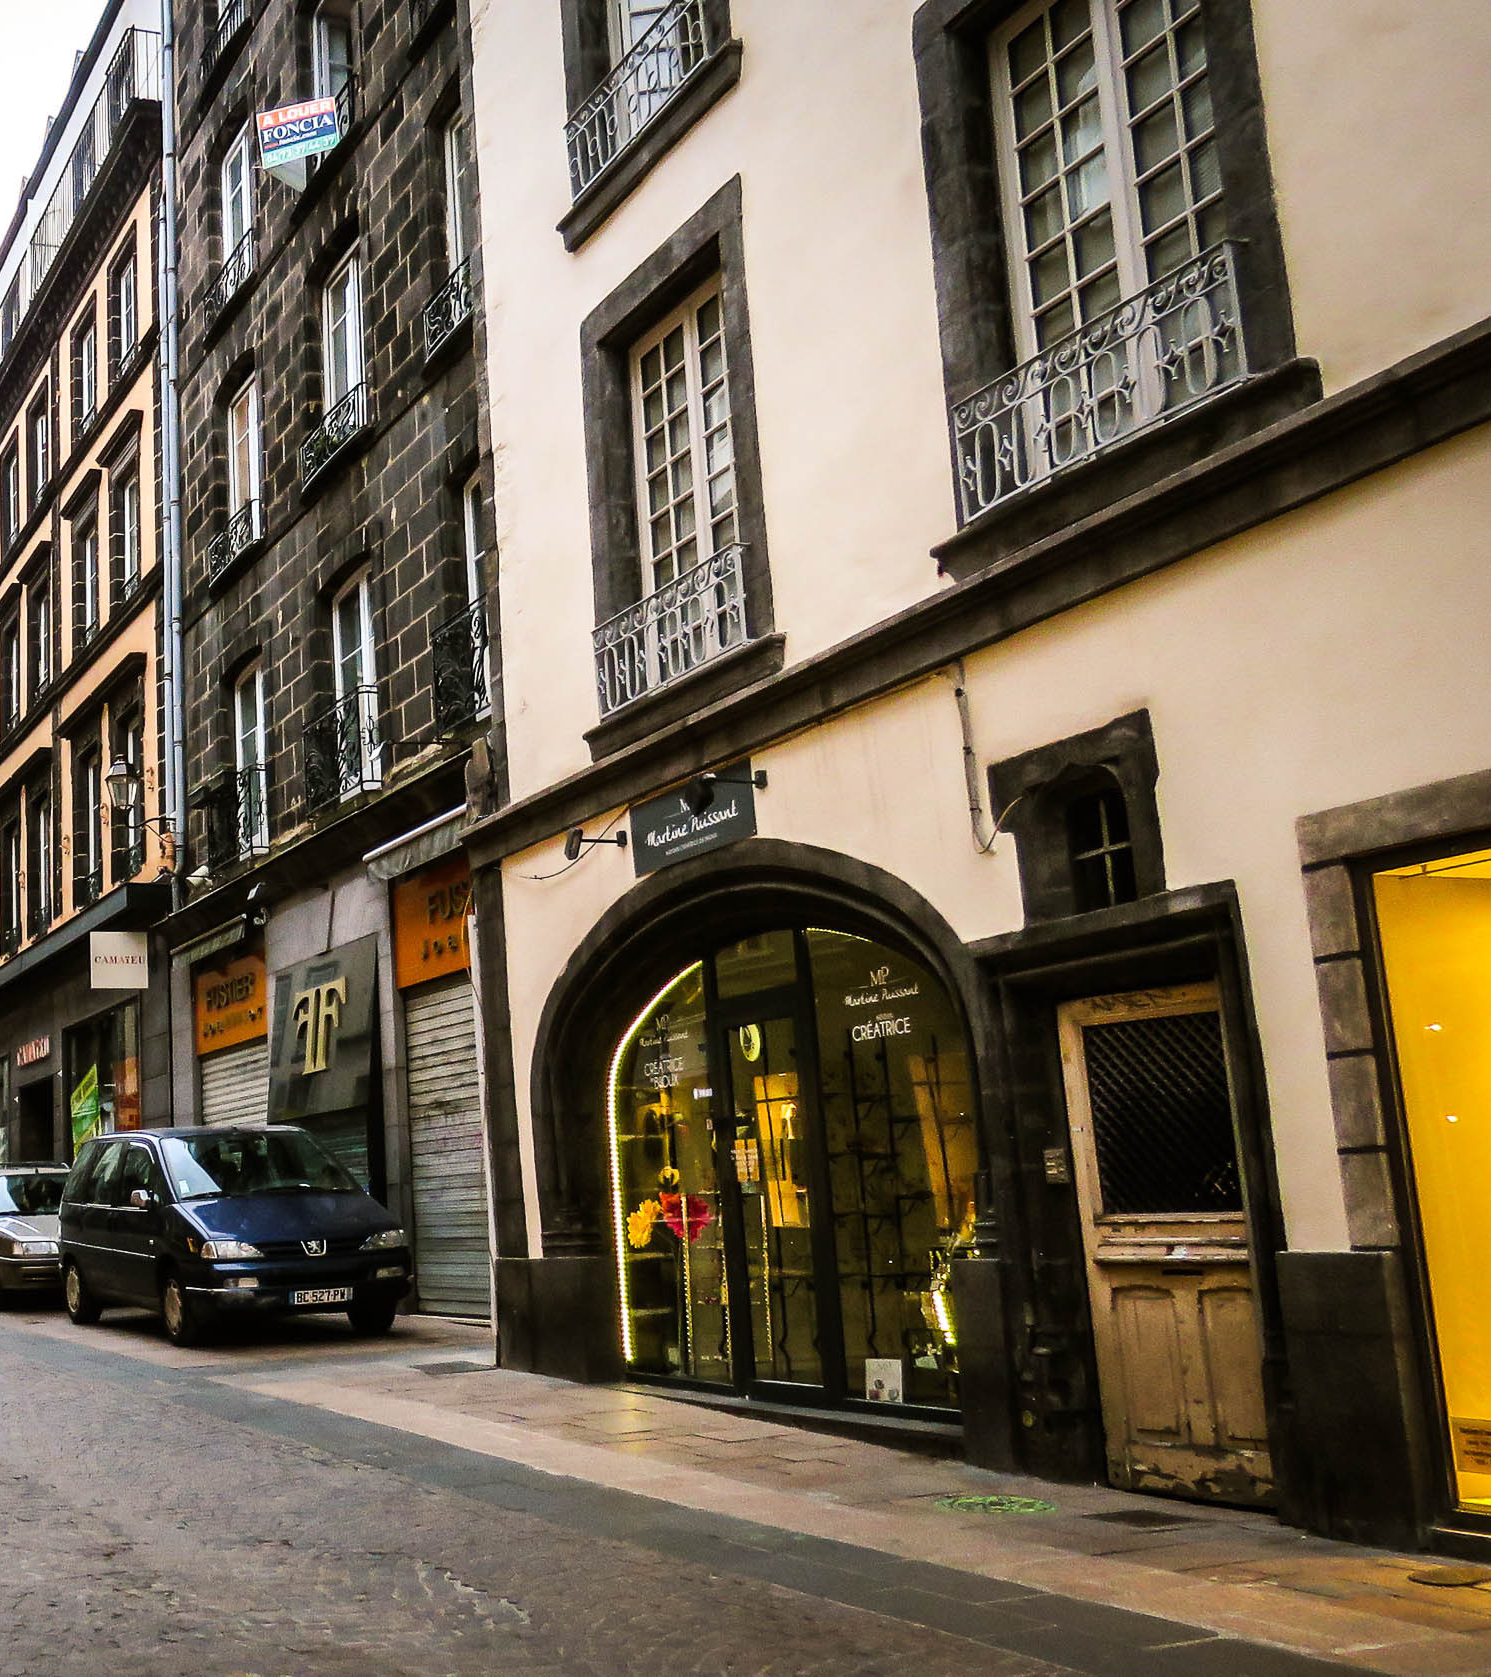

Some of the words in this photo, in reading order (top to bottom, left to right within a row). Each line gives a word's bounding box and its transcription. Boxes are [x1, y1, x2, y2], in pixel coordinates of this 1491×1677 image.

[262, 114, 274, 127] A
[278, 101, 331, 123] LOUER
[261, 114, 333, 144] FONCIA
[645, 823, 688, 847] Martine
[689, 799, 739, 832] Puissant
[94, 953, 145, 965] CAMAÏEU
[869, 966, 889, 987] MP
[852, 1017, 911, 1042] CRÉATRICE
